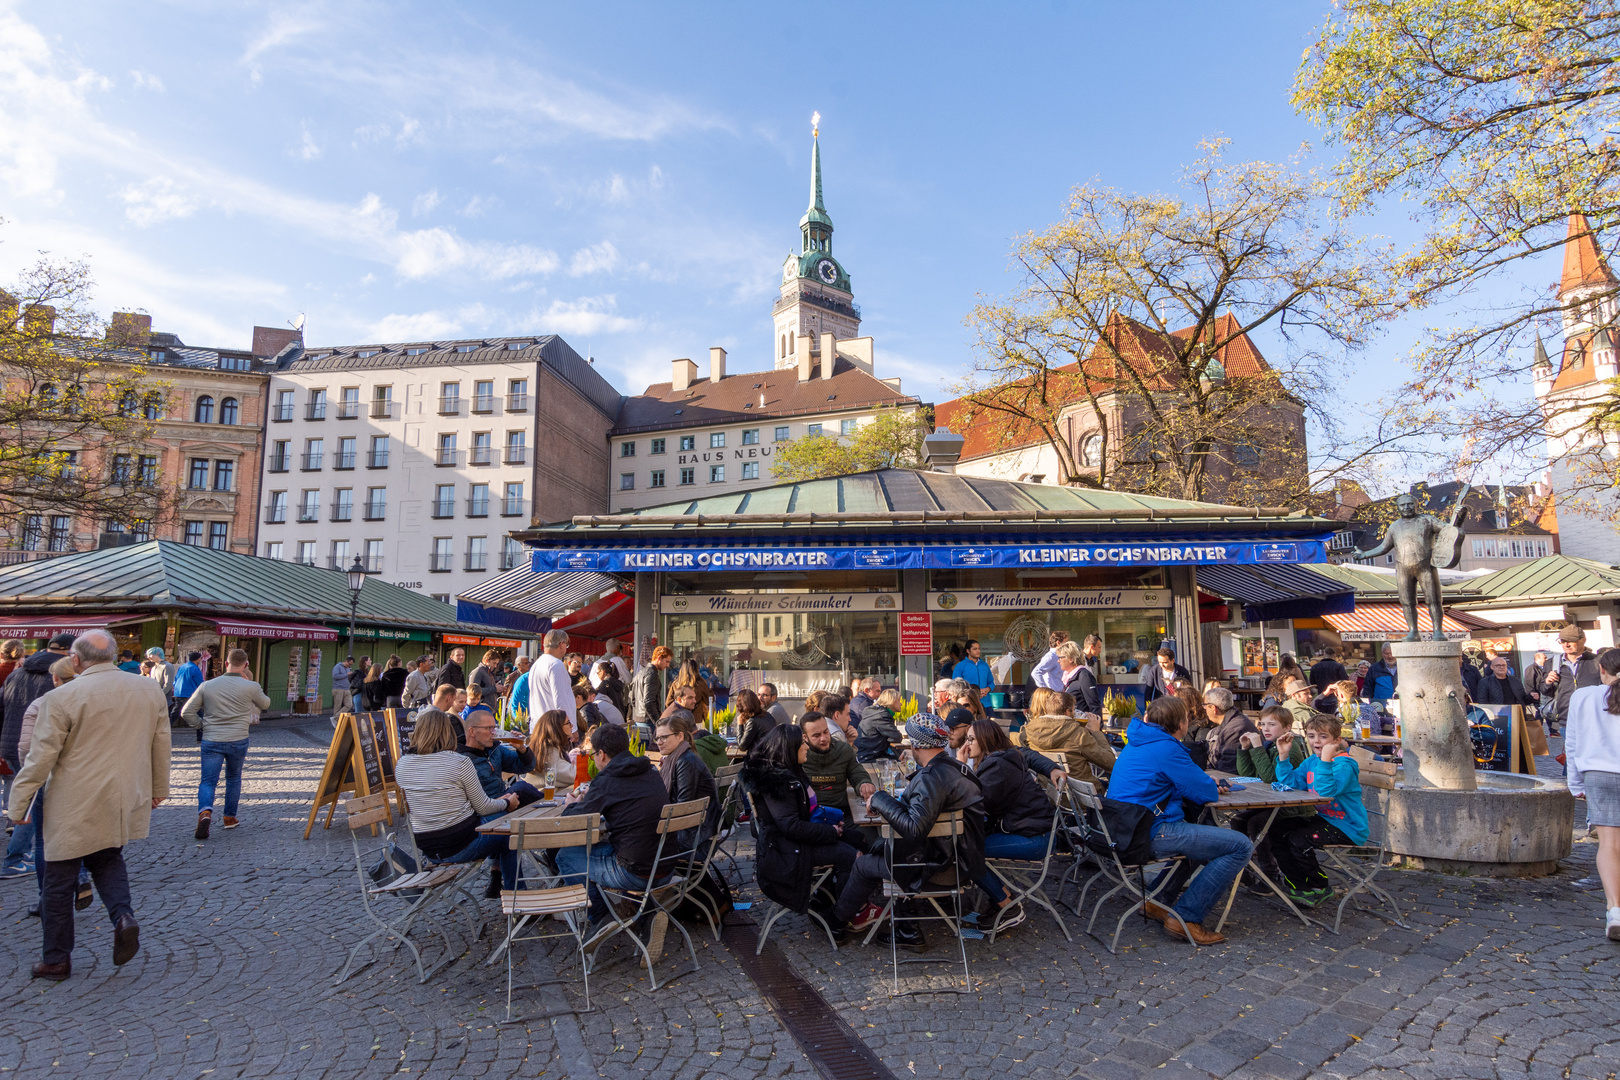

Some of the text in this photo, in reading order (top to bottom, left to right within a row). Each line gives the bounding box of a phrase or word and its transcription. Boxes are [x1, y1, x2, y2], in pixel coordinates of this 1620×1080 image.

[678, 451, 724, 465] HAUS
[624, 552, 828, 567] KLEINER OCHS'NBRATER
[1019, 547, 1227, 563] KLEINER OCHS'NBRATER
[708, 595, 853, 610] Münchner Schmankerl
[976, 592, 1122, 607] Münchner Schmankerl
[8, 629, 28, 637] GIFTS
[221, 626, 248, 636] SOUVENIRS
[248, 627, 275, 637] GESCHENKE
[281, 630, 294, 638] GIFTS
